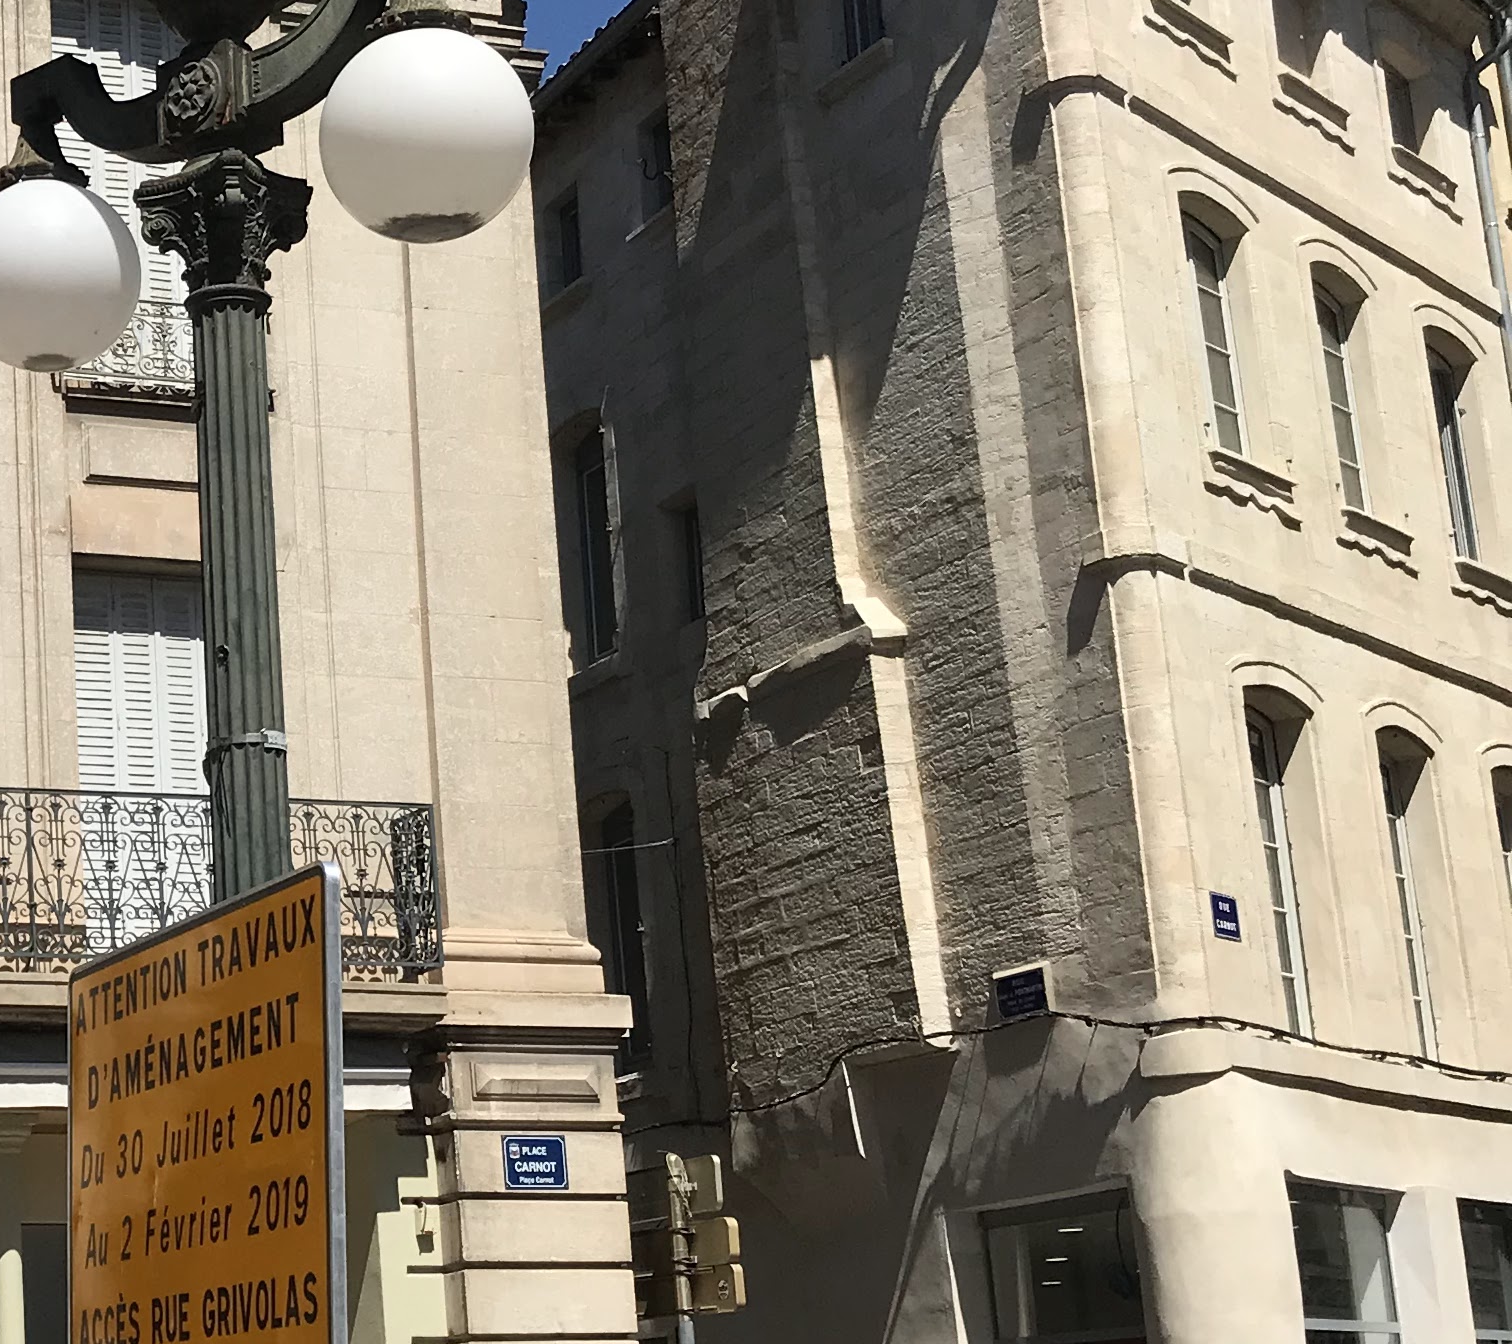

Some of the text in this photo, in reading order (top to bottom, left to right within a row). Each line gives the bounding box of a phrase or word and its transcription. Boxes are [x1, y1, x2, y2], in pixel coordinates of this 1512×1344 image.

[76, 893, 317, 1036] ATTENTION TRAVAUX
[88, 992, 300, 1111] D'AMÉNAGEMENT
[80, 1078, 313, 1190] Du 30 Juillet 2018
[514, 1161, 557, 1172] CARNOT
[522, 1146, 547, 1155] PLACE
[84, 1174, 309, 1269] Au 2 Février 2019
[203, 1271, 319, 1338] GRIVOLAS
